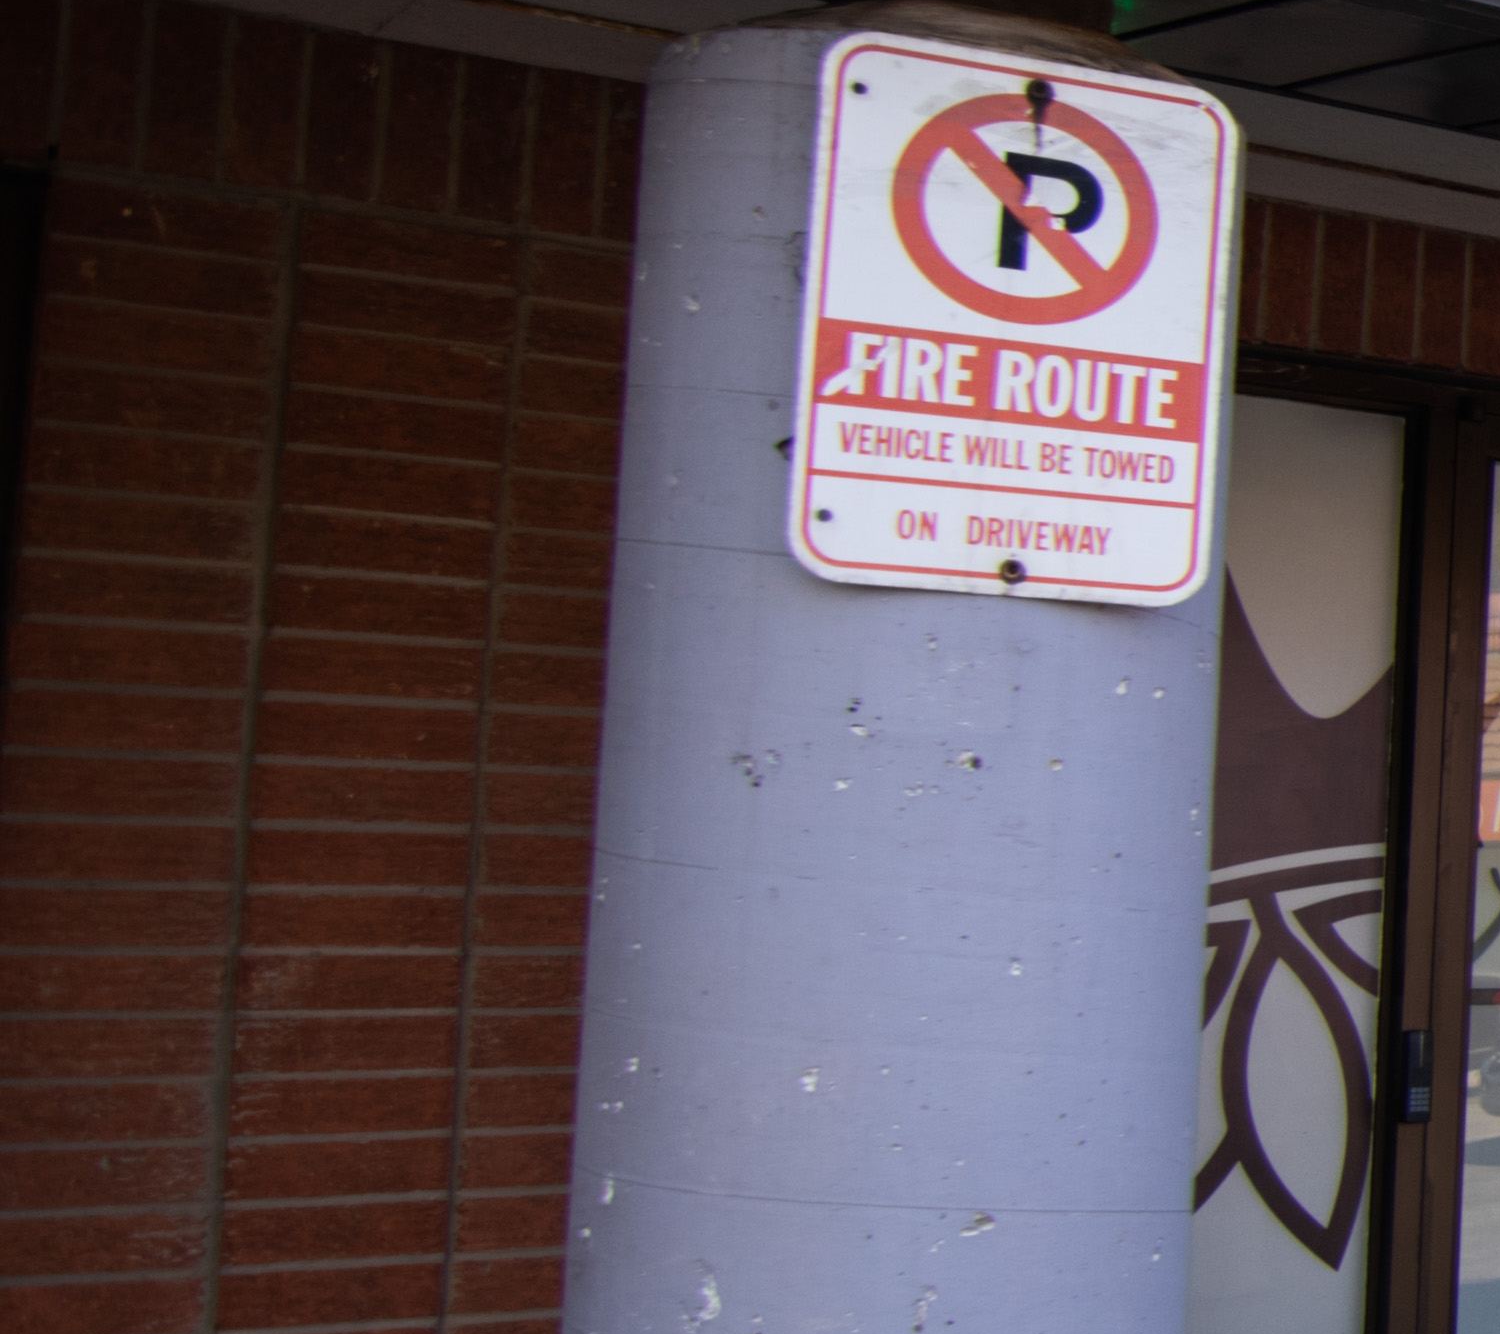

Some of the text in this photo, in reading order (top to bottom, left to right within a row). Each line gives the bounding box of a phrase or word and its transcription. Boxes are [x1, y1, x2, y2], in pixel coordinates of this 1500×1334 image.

[846, 331, 1179, 429] FIRE ROUTE
[838, 421, 1175, 484] VEHICLE WILL BE TOWED
[897, 509, 1111, 555] ON DRIVEWAY
